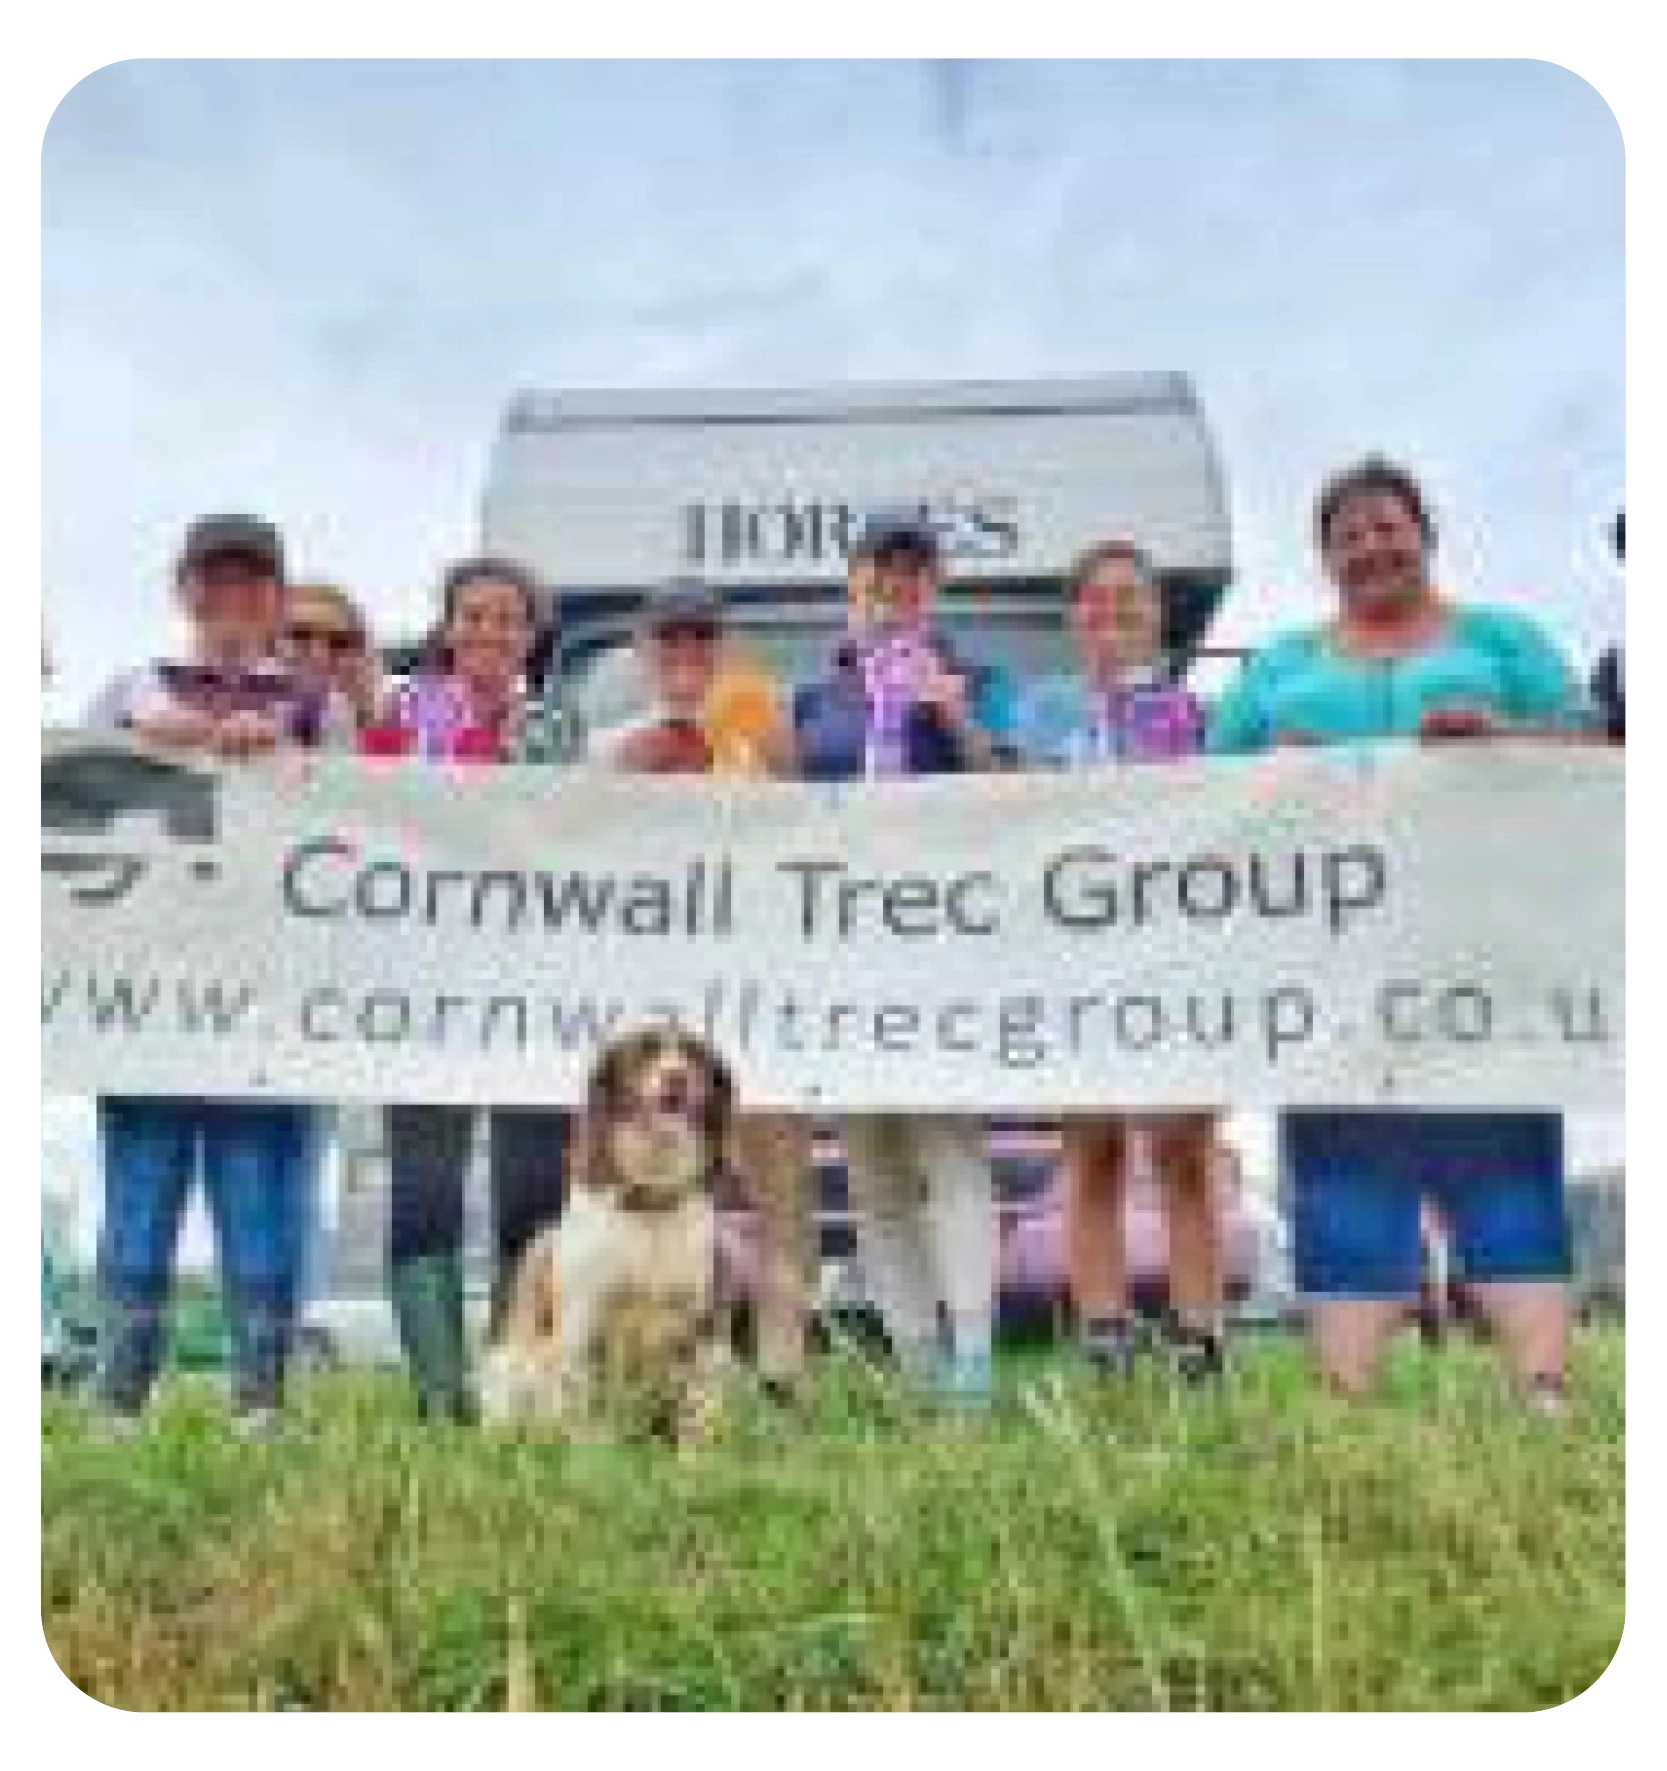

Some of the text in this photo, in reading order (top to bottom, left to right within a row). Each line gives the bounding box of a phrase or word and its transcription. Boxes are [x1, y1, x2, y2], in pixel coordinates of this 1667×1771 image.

[283, 838, 1387, 938] Cornwall Trec Group
